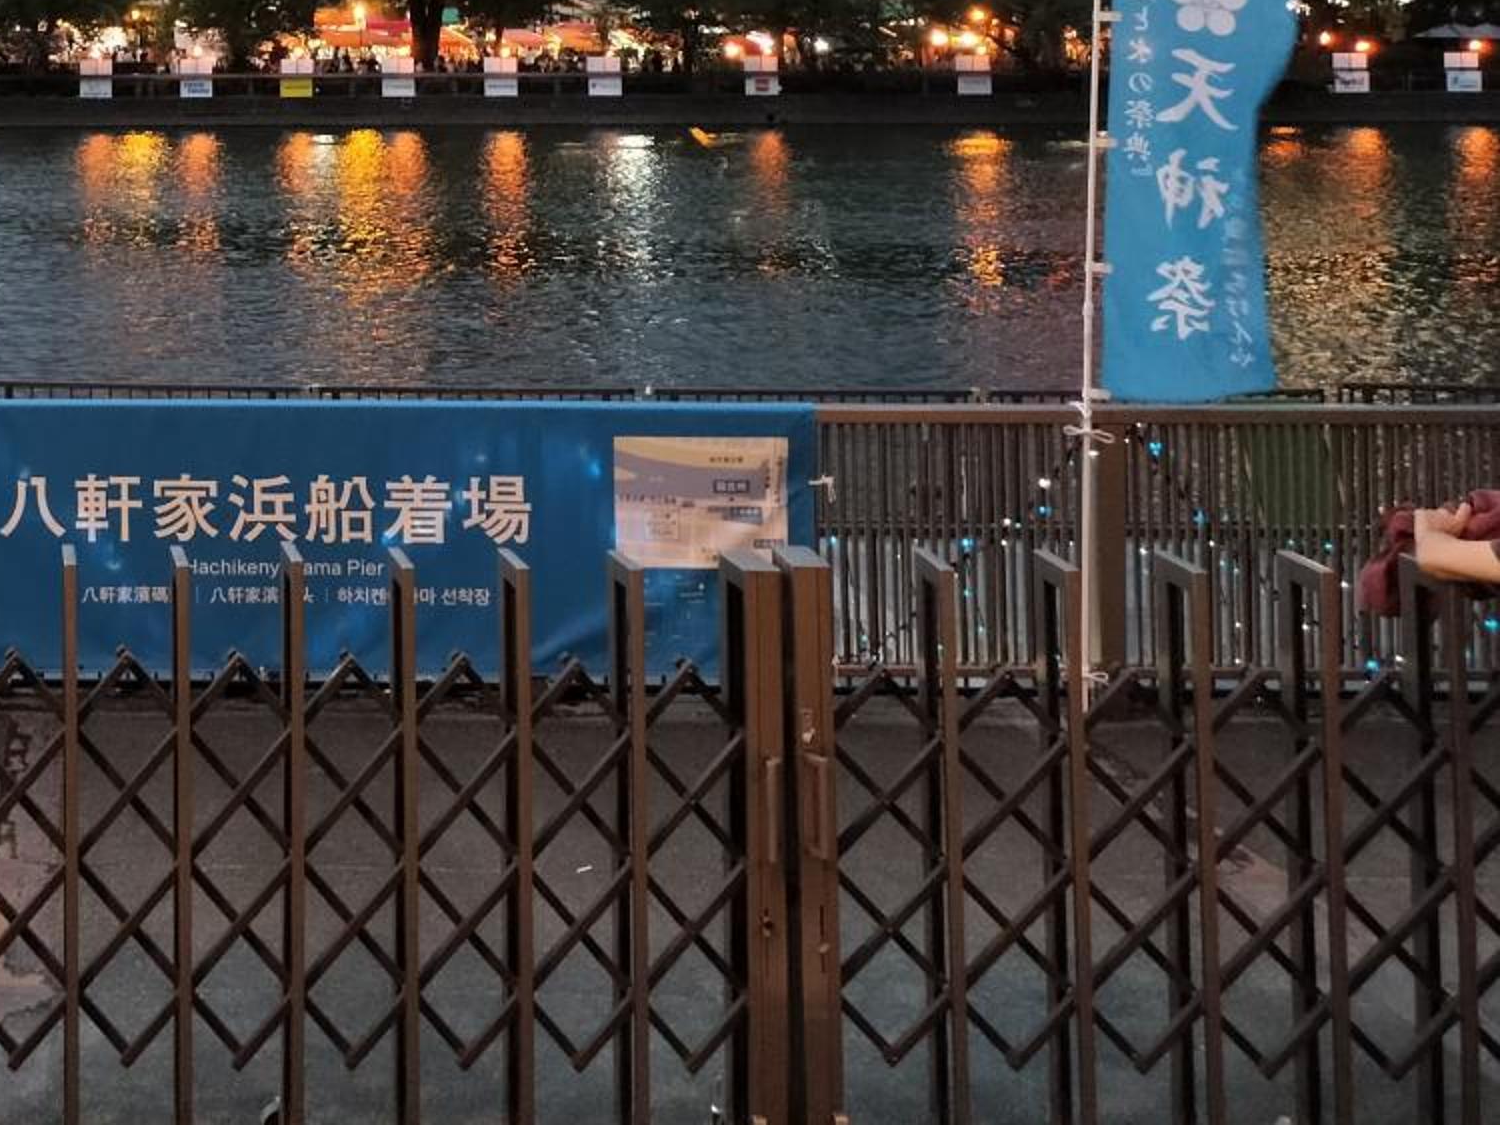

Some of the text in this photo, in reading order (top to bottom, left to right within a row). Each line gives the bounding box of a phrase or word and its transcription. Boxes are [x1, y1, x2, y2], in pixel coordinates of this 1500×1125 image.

[0, 474, 533, 544] 八軒家浜船着場
[188, 558, 385, 578] Hachikenyama Pier
[82, 586, 172, 604] 八軒家濱碼
[441, 586, 490, 607] 선착장
